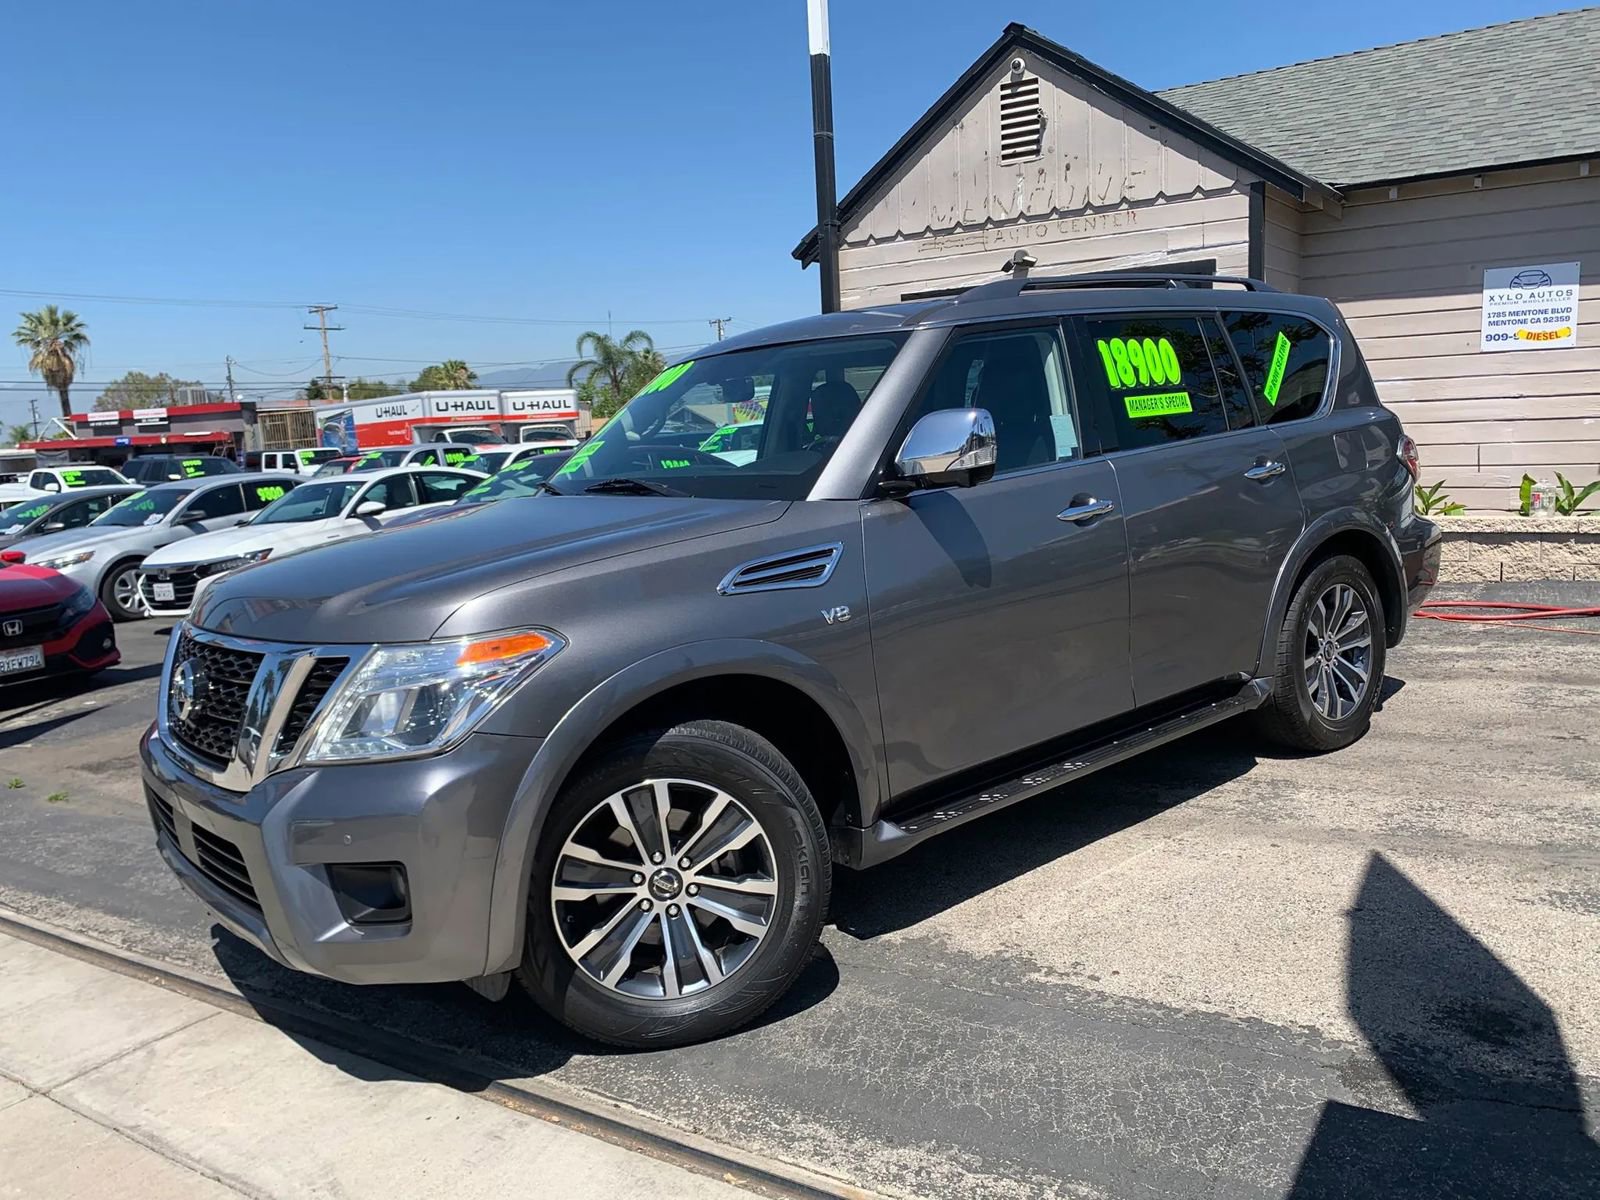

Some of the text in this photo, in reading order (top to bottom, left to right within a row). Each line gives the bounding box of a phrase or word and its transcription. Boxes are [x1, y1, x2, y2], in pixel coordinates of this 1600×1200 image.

[993, 210, 1137, 244] AUTO CENTER
[1489, 289, 1573, 302] XYLO AUTOS
[1487, 306, 1572, 319] 1785 MENTONE BLVD
[1488, 318, 1528, 327] MENTONE
[1526, 331, 1561, 341] DIESEL
[1276, 336, 1287, 369] SEATING
[1097, 338, 1181, 388] 18900
[436, 400, 495, 412] U-HAUL
[513, 399, 571, 411] U-HAUL
[1128, 395, 1189, 411] MANAGER'S SPECIAL
[376, 405, 408, 418] U-HAUL
[821, 605, 851, 625] V8
